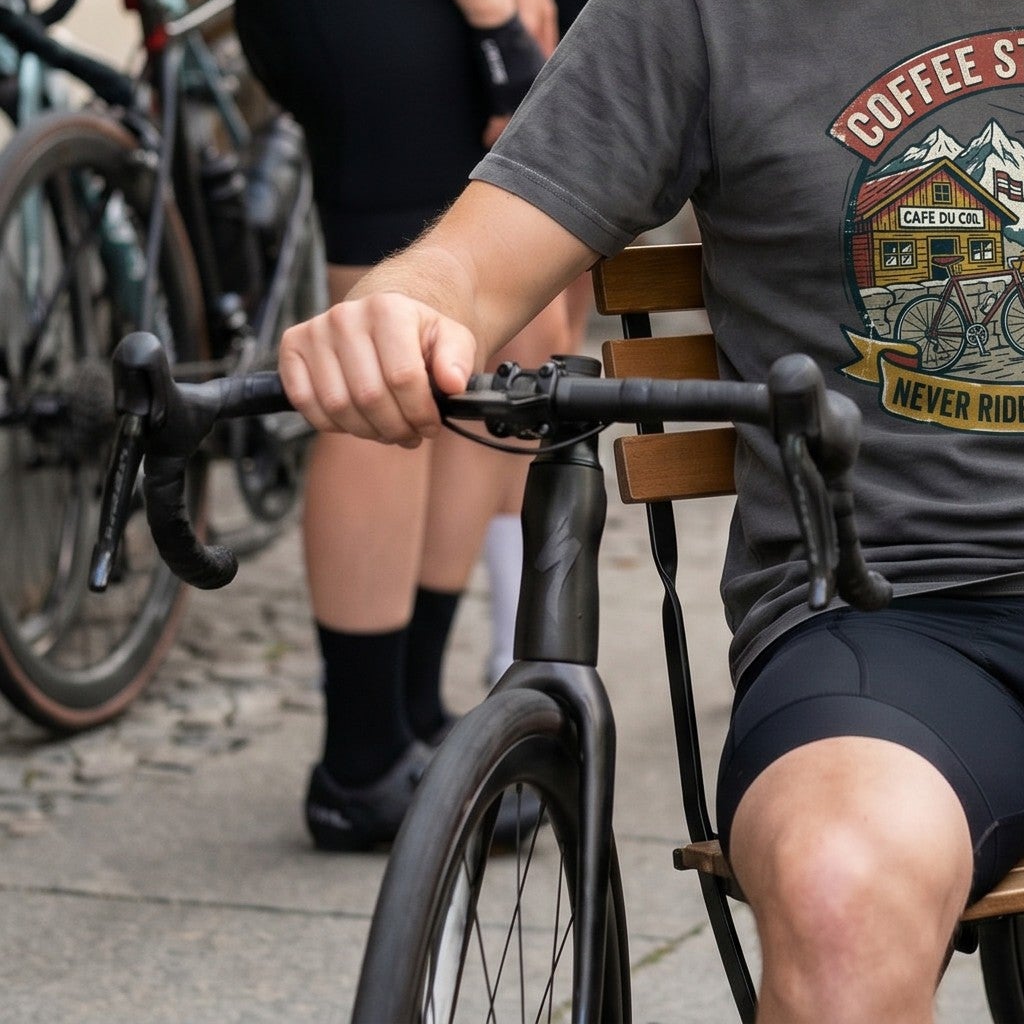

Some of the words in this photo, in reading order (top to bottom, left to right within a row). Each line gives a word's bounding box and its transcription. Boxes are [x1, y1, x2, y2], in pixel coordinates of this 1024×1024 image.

[847, 45, 983, 147] COFFEE
[903, 210, 936, 224] CAFE
[939, 212, 956, 225] DU
[892, 377, 969, 421] NEVER
